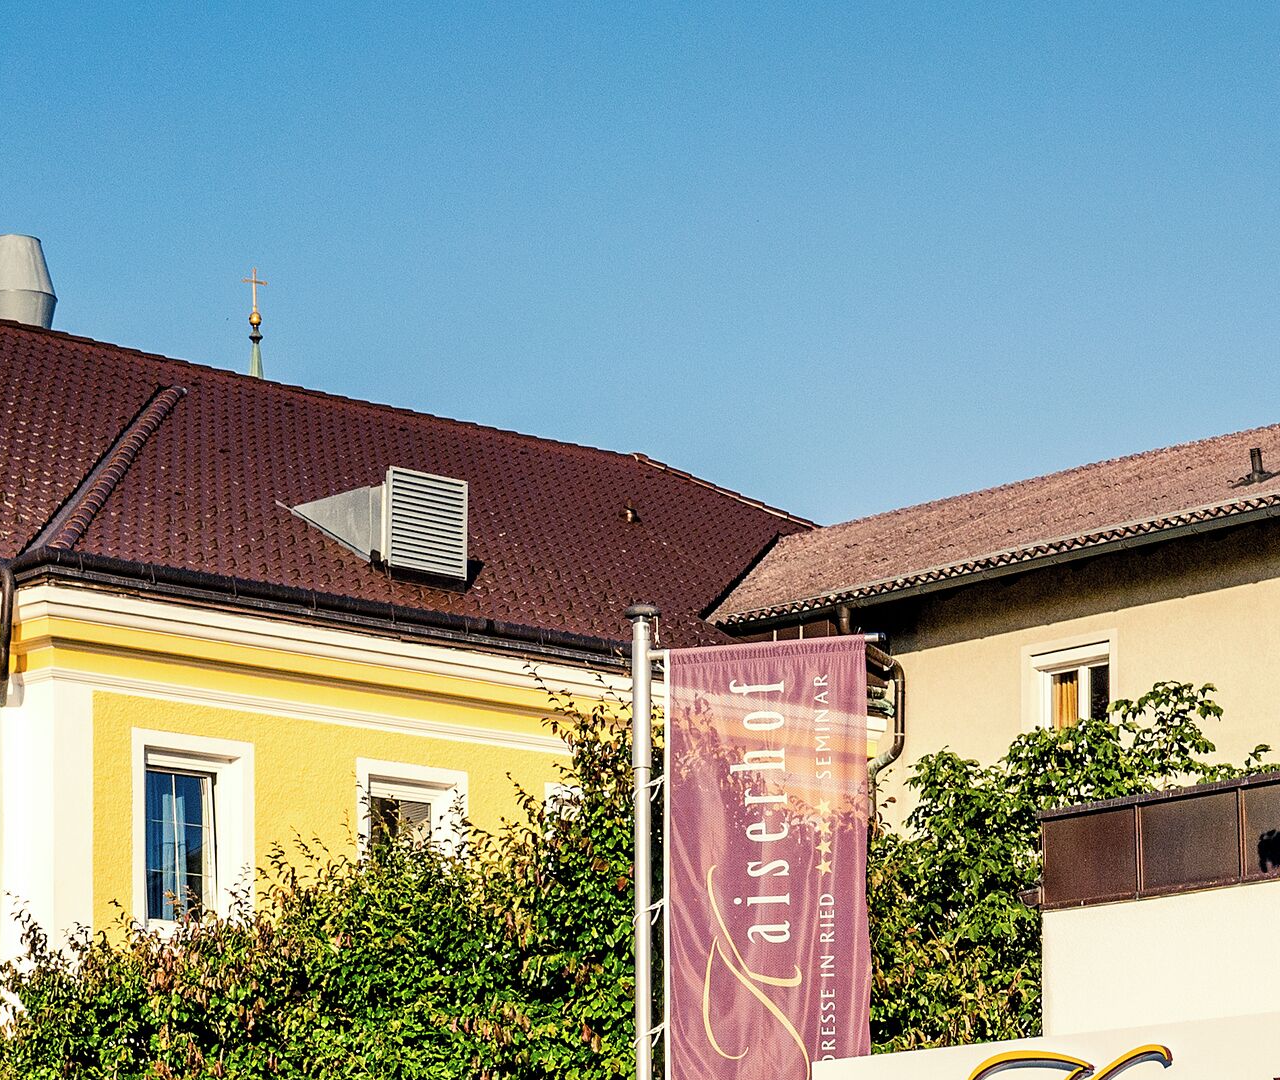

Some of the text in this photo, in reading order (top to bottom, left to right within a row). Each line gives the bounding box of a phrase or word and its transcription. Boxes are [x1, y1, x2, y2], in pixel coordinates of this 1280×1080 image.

[813, 674, 837, 1062] DRESSE IN RIED SEMINAR
